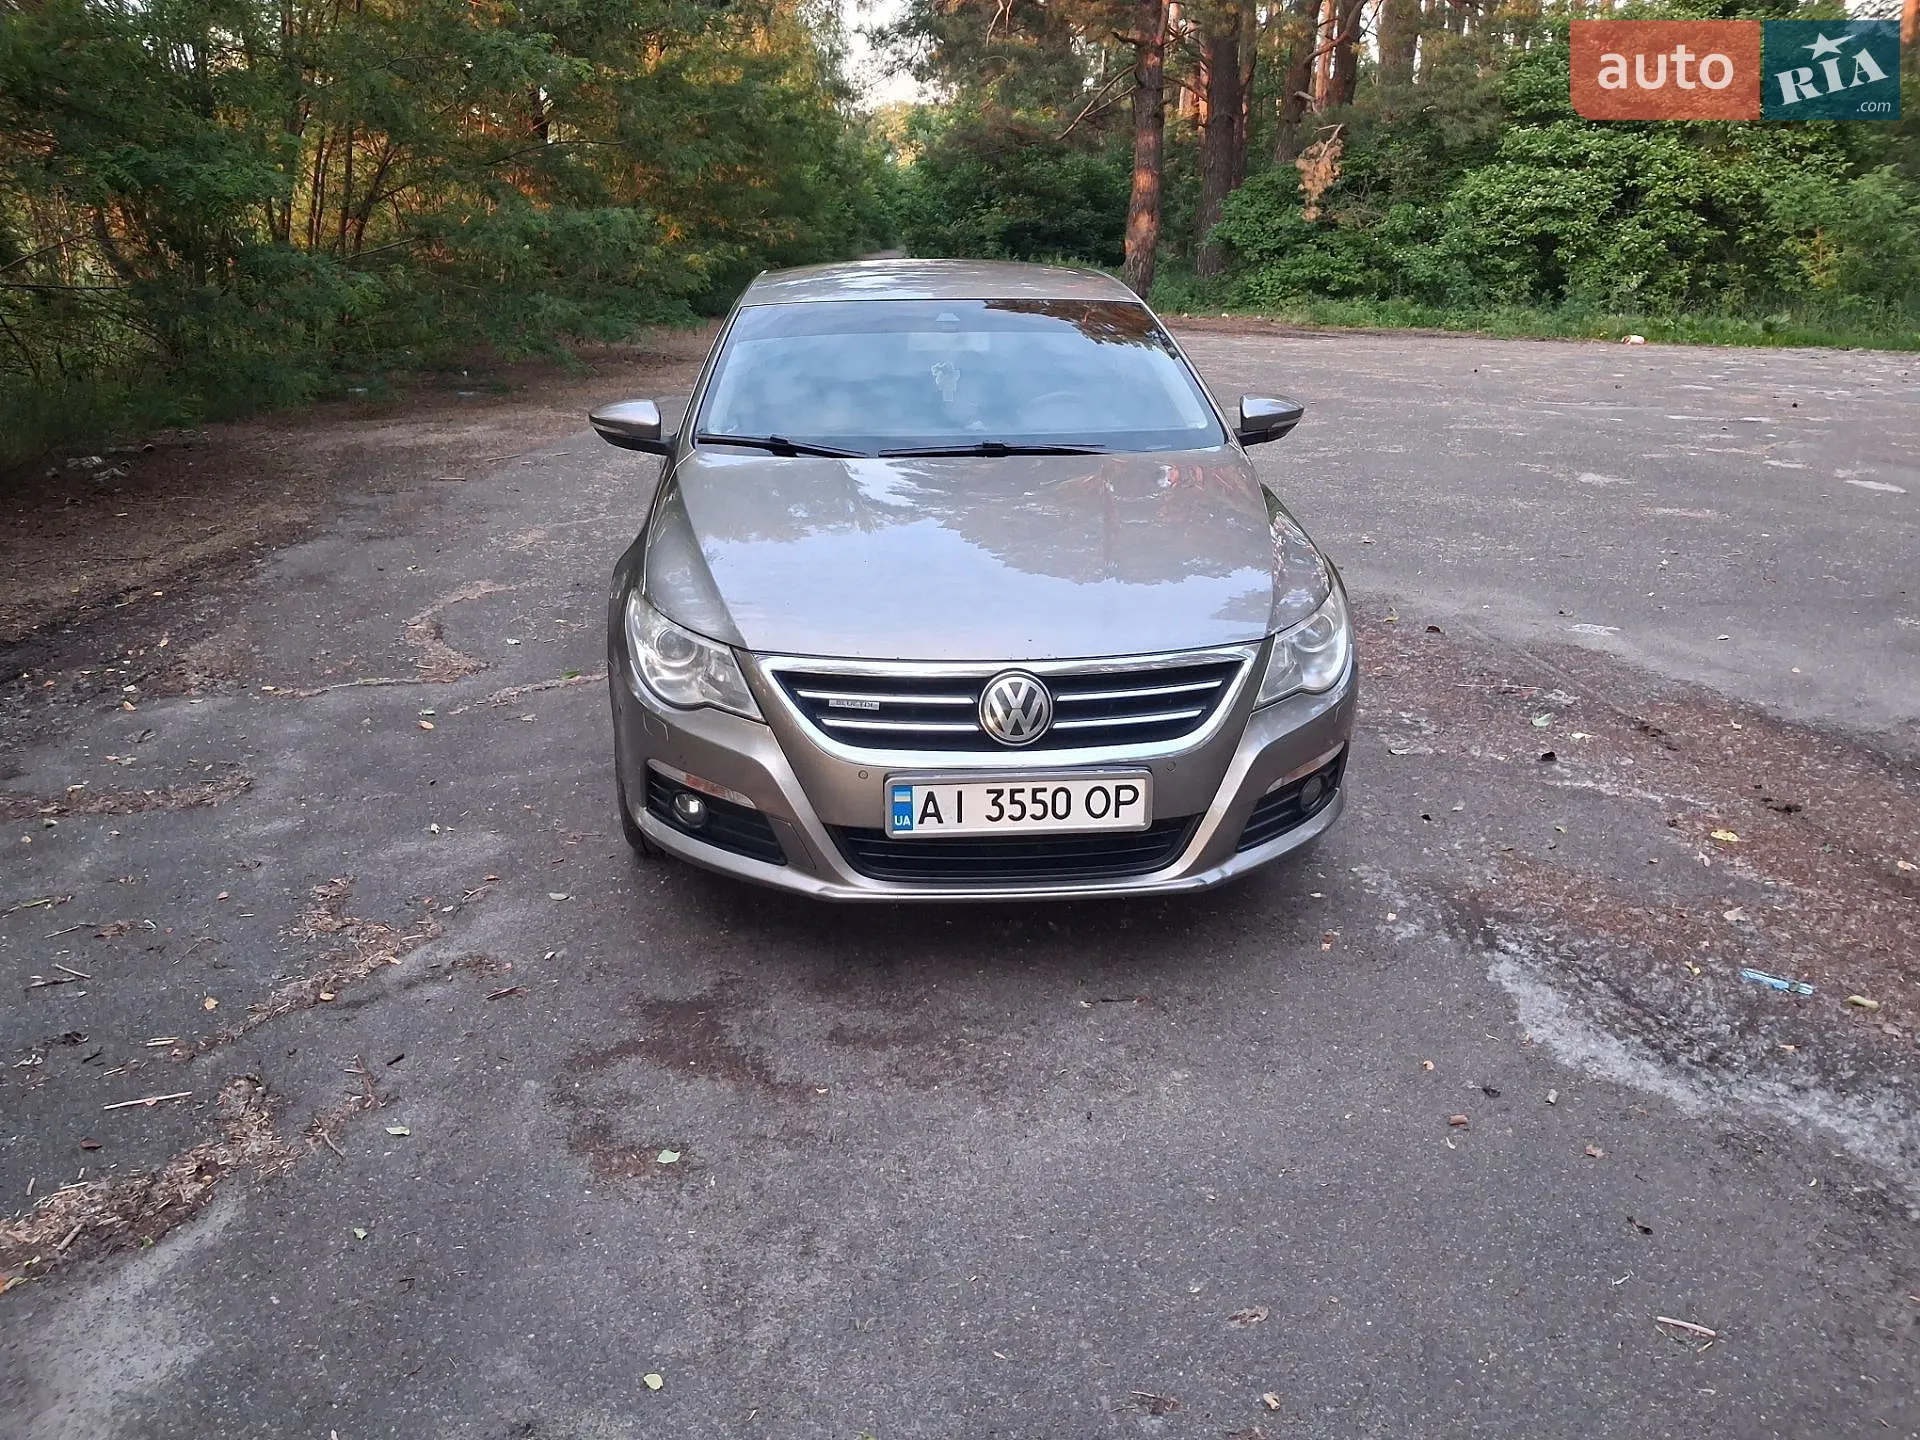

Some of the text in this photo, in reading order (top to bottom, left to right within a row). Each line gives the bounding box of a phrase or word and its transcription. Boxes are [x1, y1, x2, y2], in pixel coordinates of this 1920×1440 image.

[985, 786, 1072, 823] 3550
[1085, 784, 1140, 819] OP
[894, 815, 911, 826] UA
